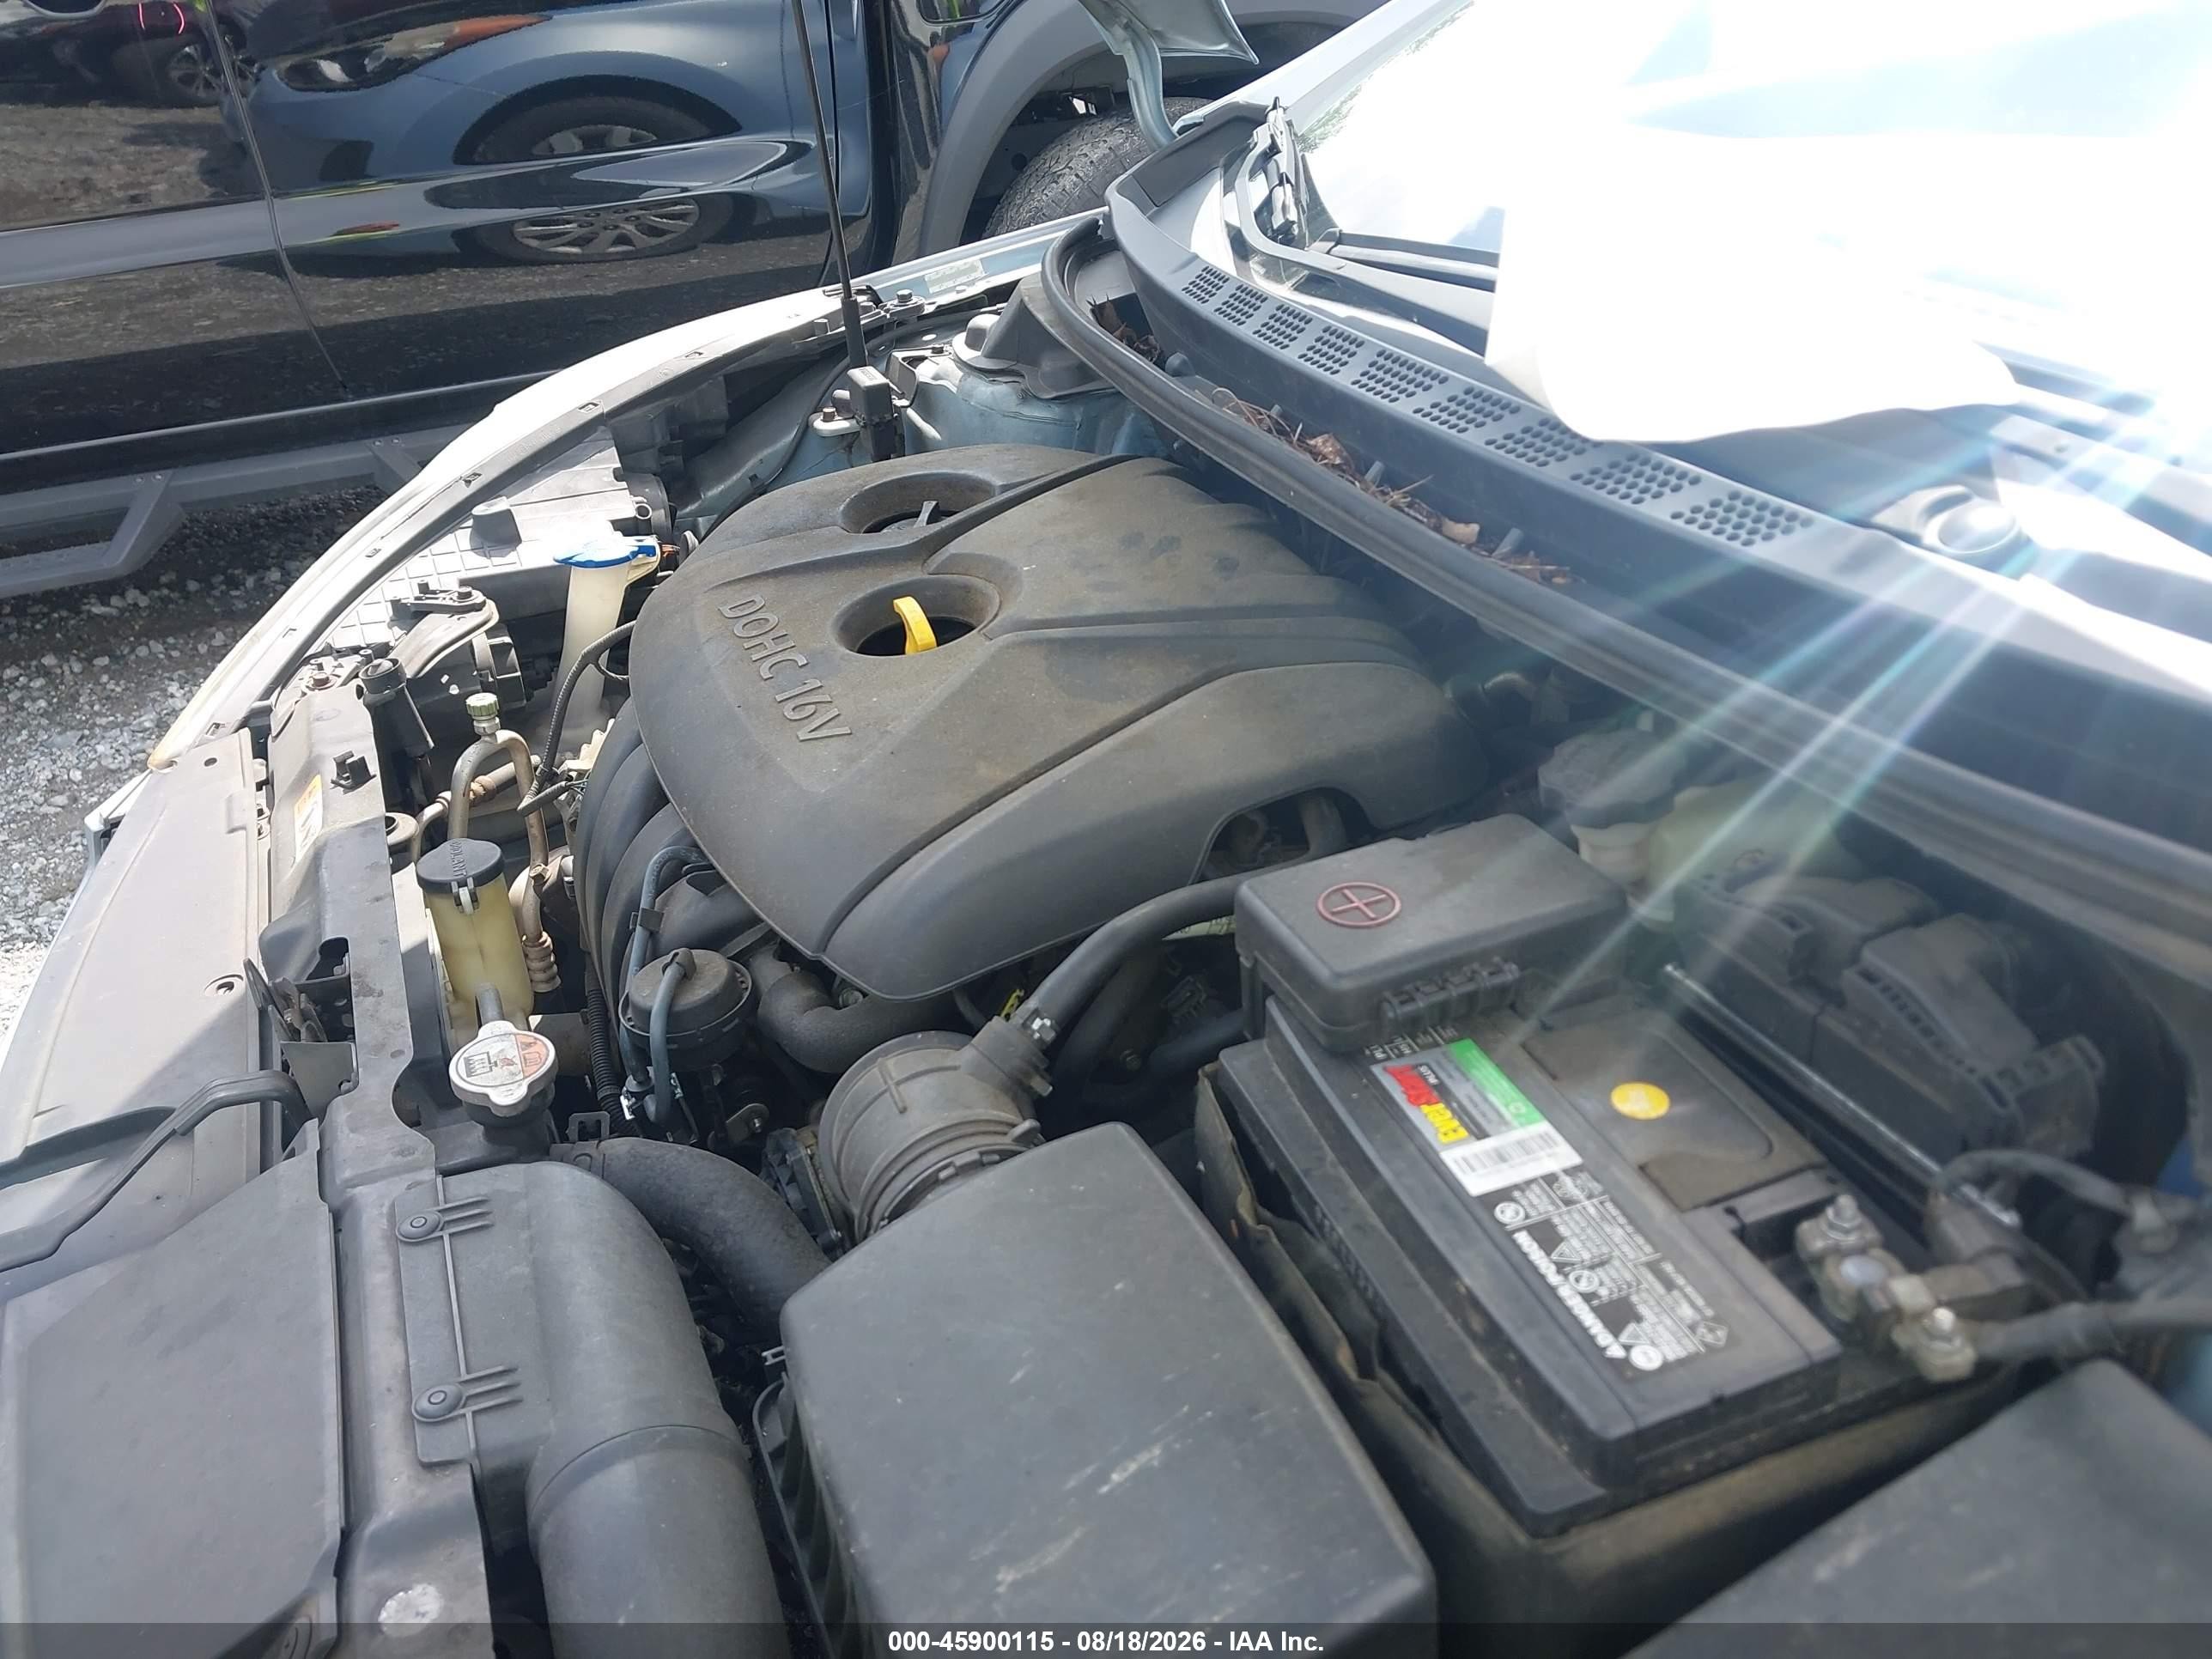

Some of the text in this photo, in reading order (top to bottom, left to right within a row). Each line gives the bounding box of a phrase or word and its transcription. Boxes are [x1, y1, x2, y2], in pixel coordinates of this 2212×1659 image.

[717, 593, 853, 742] DOHC 16V
[1417, 1064, 1440, 1085] PLUS
